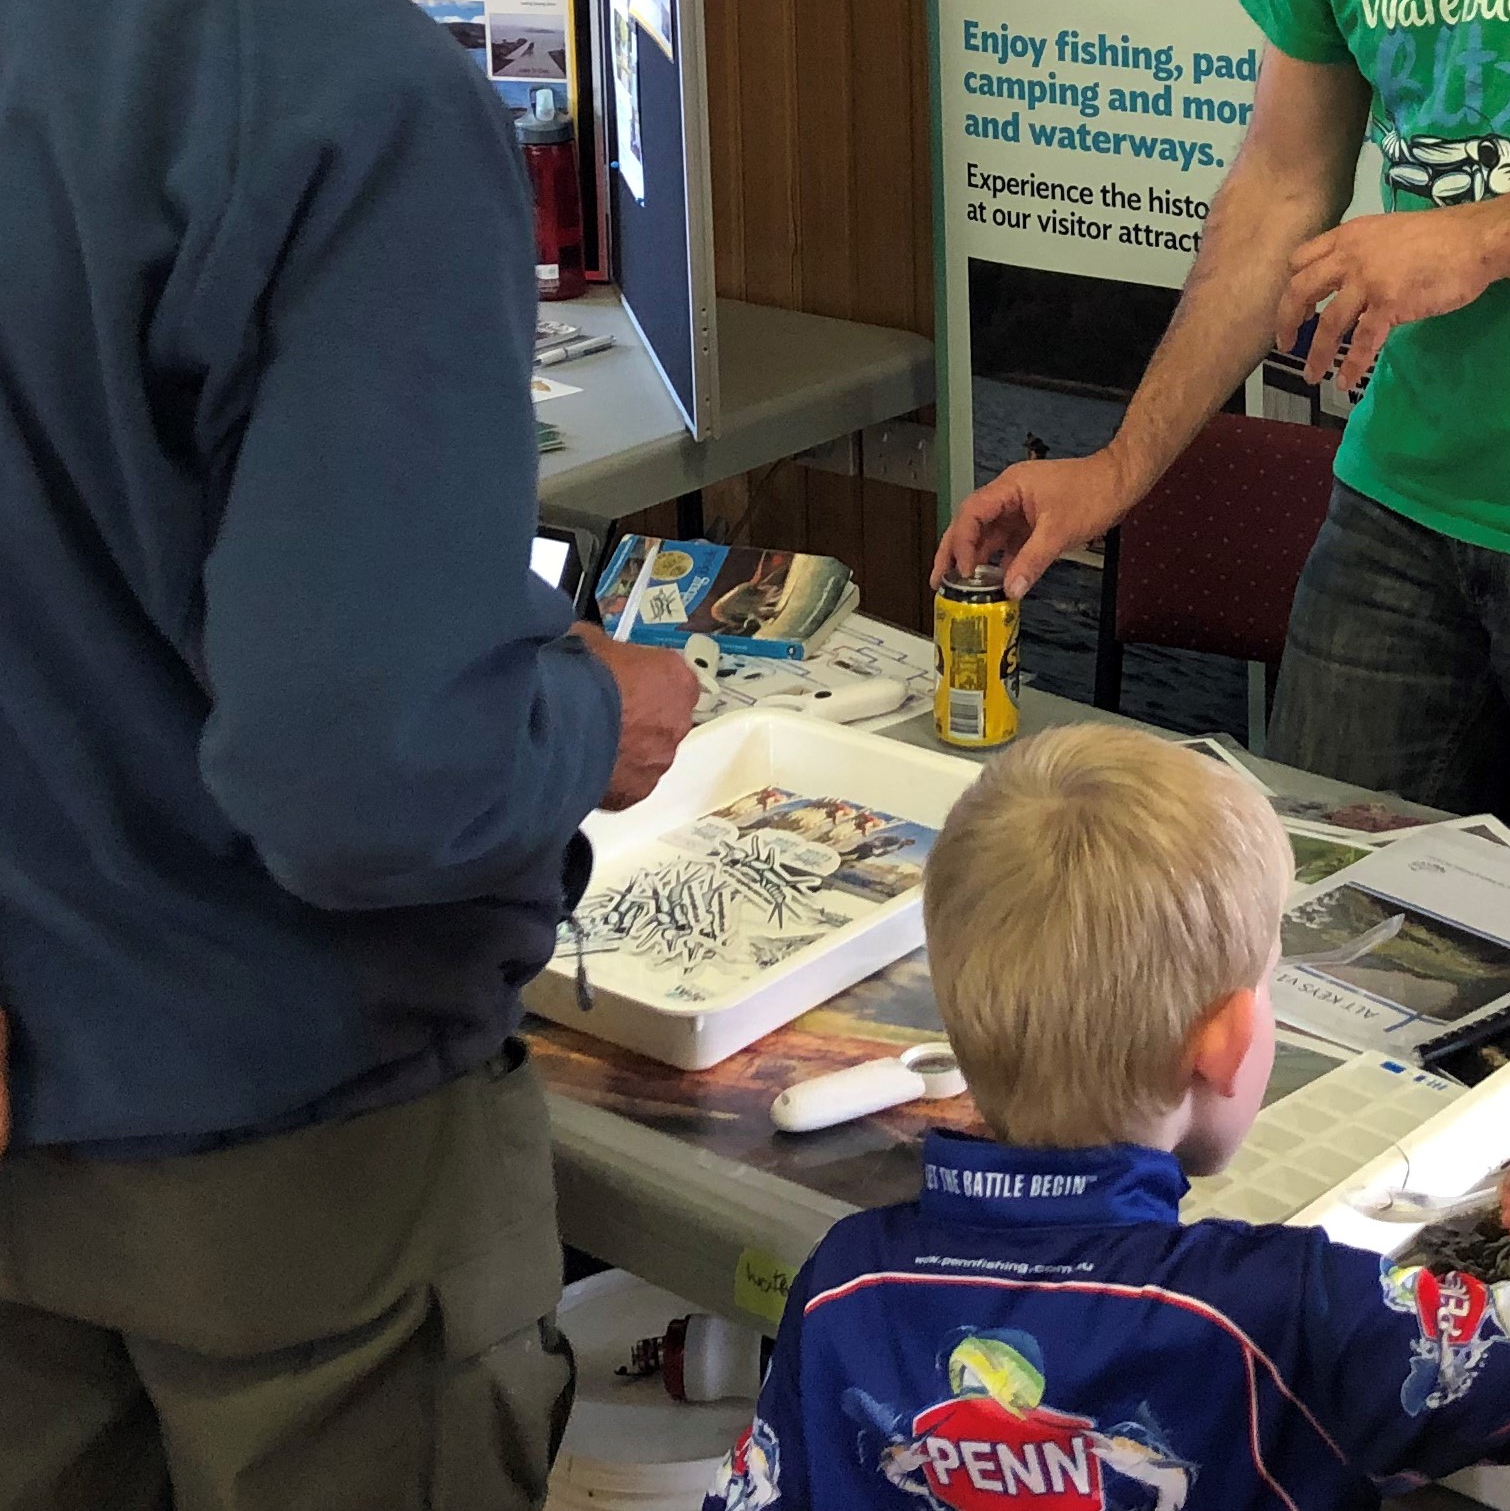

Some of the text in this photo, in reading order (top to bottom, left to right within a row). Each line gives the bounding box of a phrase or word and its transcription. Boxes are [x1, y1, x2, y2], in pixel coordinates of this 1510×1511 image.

[964, 19, 1257, 84] Enjoy fishing, pad
[964, 70, 1254, 126] camping and mor
[964, 112, 1225, 172] and waterways.
[967, 163, 1210, 219] Experience the histo
[967, 200, 1203, 252] at our visitor attract
[962, 1170, 1026, 1198] BATTLE
[923, 1435, 1090, 1497] PENN
